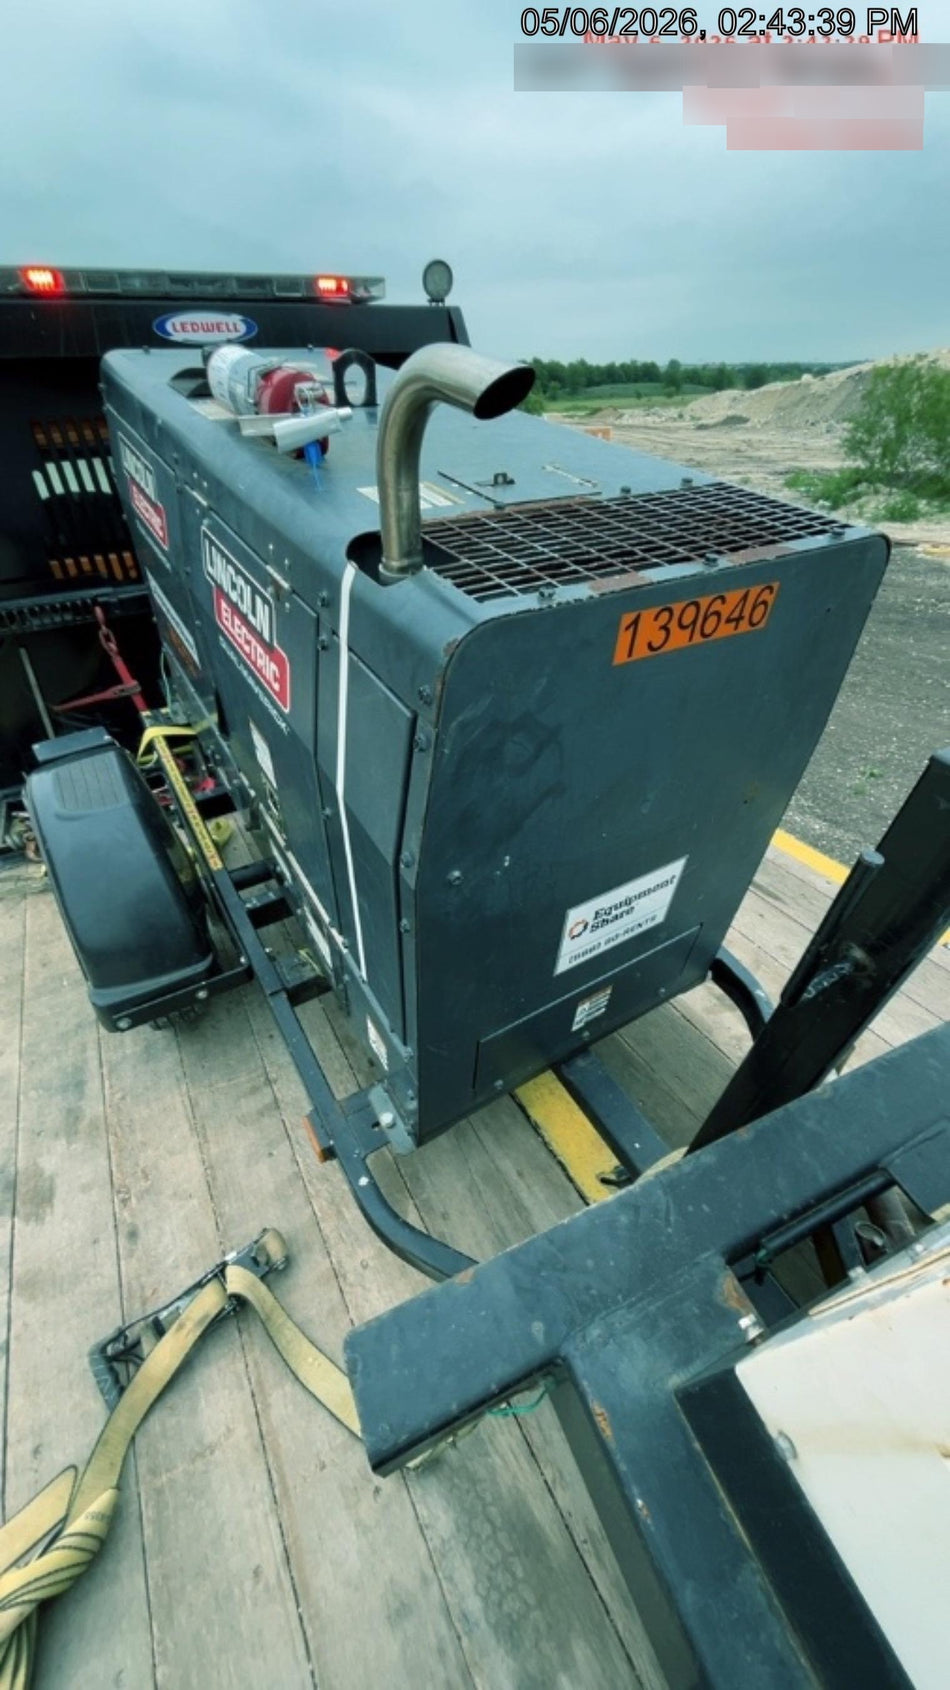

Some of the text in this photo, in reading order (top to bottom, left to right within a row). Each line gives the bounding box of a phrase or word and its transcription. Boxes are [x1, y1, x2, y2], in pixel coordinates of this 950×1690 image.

[172, 321, 240, 333] LEDWELL
[204, 538, 270, 644] LINCOLN
[220, 598, 281, 692] ELECTRIC
[624, 585, 774, 658] 139646
[590, 906, 635, 933] Share
[593, 874, 676, 921] Equipment
